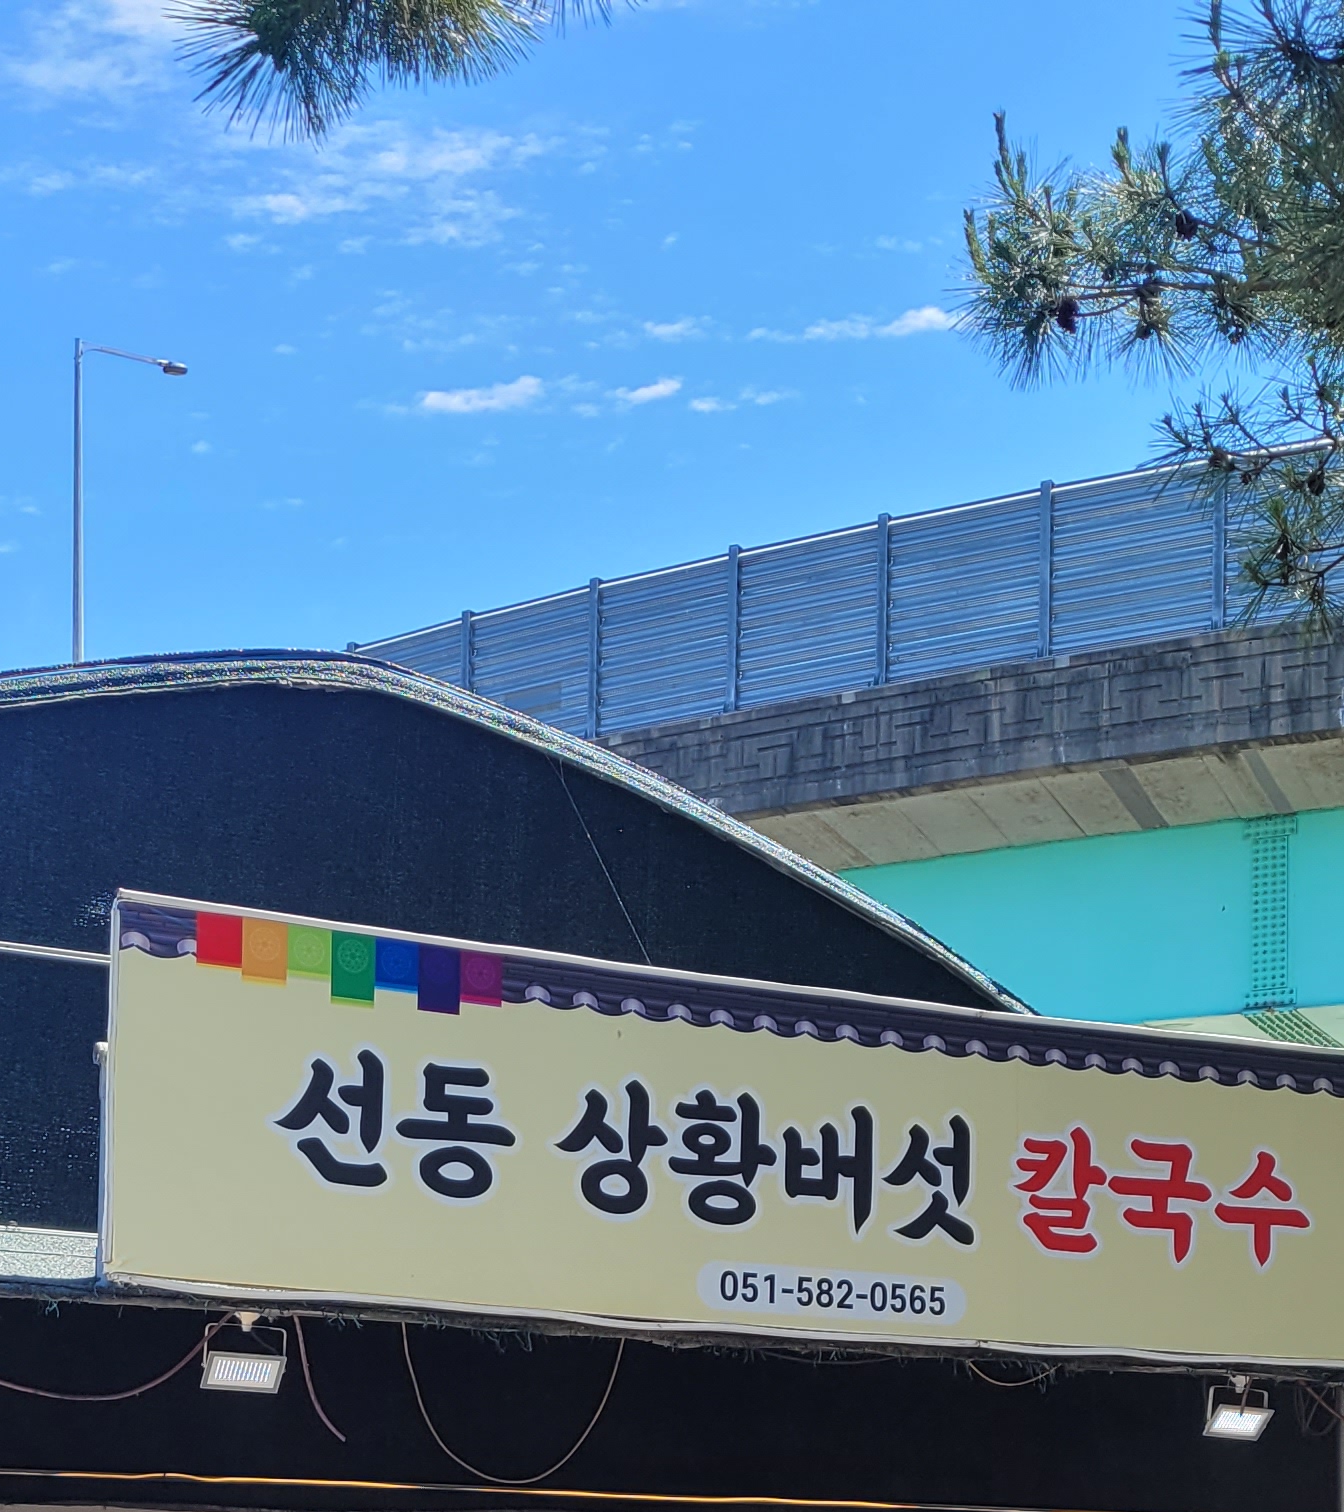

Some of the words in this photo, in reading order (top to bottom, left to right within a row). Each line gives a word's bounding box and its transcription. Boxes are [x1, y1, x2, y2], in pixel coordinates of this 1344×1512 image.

[275, 1049, 515, 1198] 선동
[556, 1080, 975, 1246] 상황버섯
[1014, 1127, 1310, 1267] 칼국수
[719, 1272, 947, 1318] 051-582-0565
